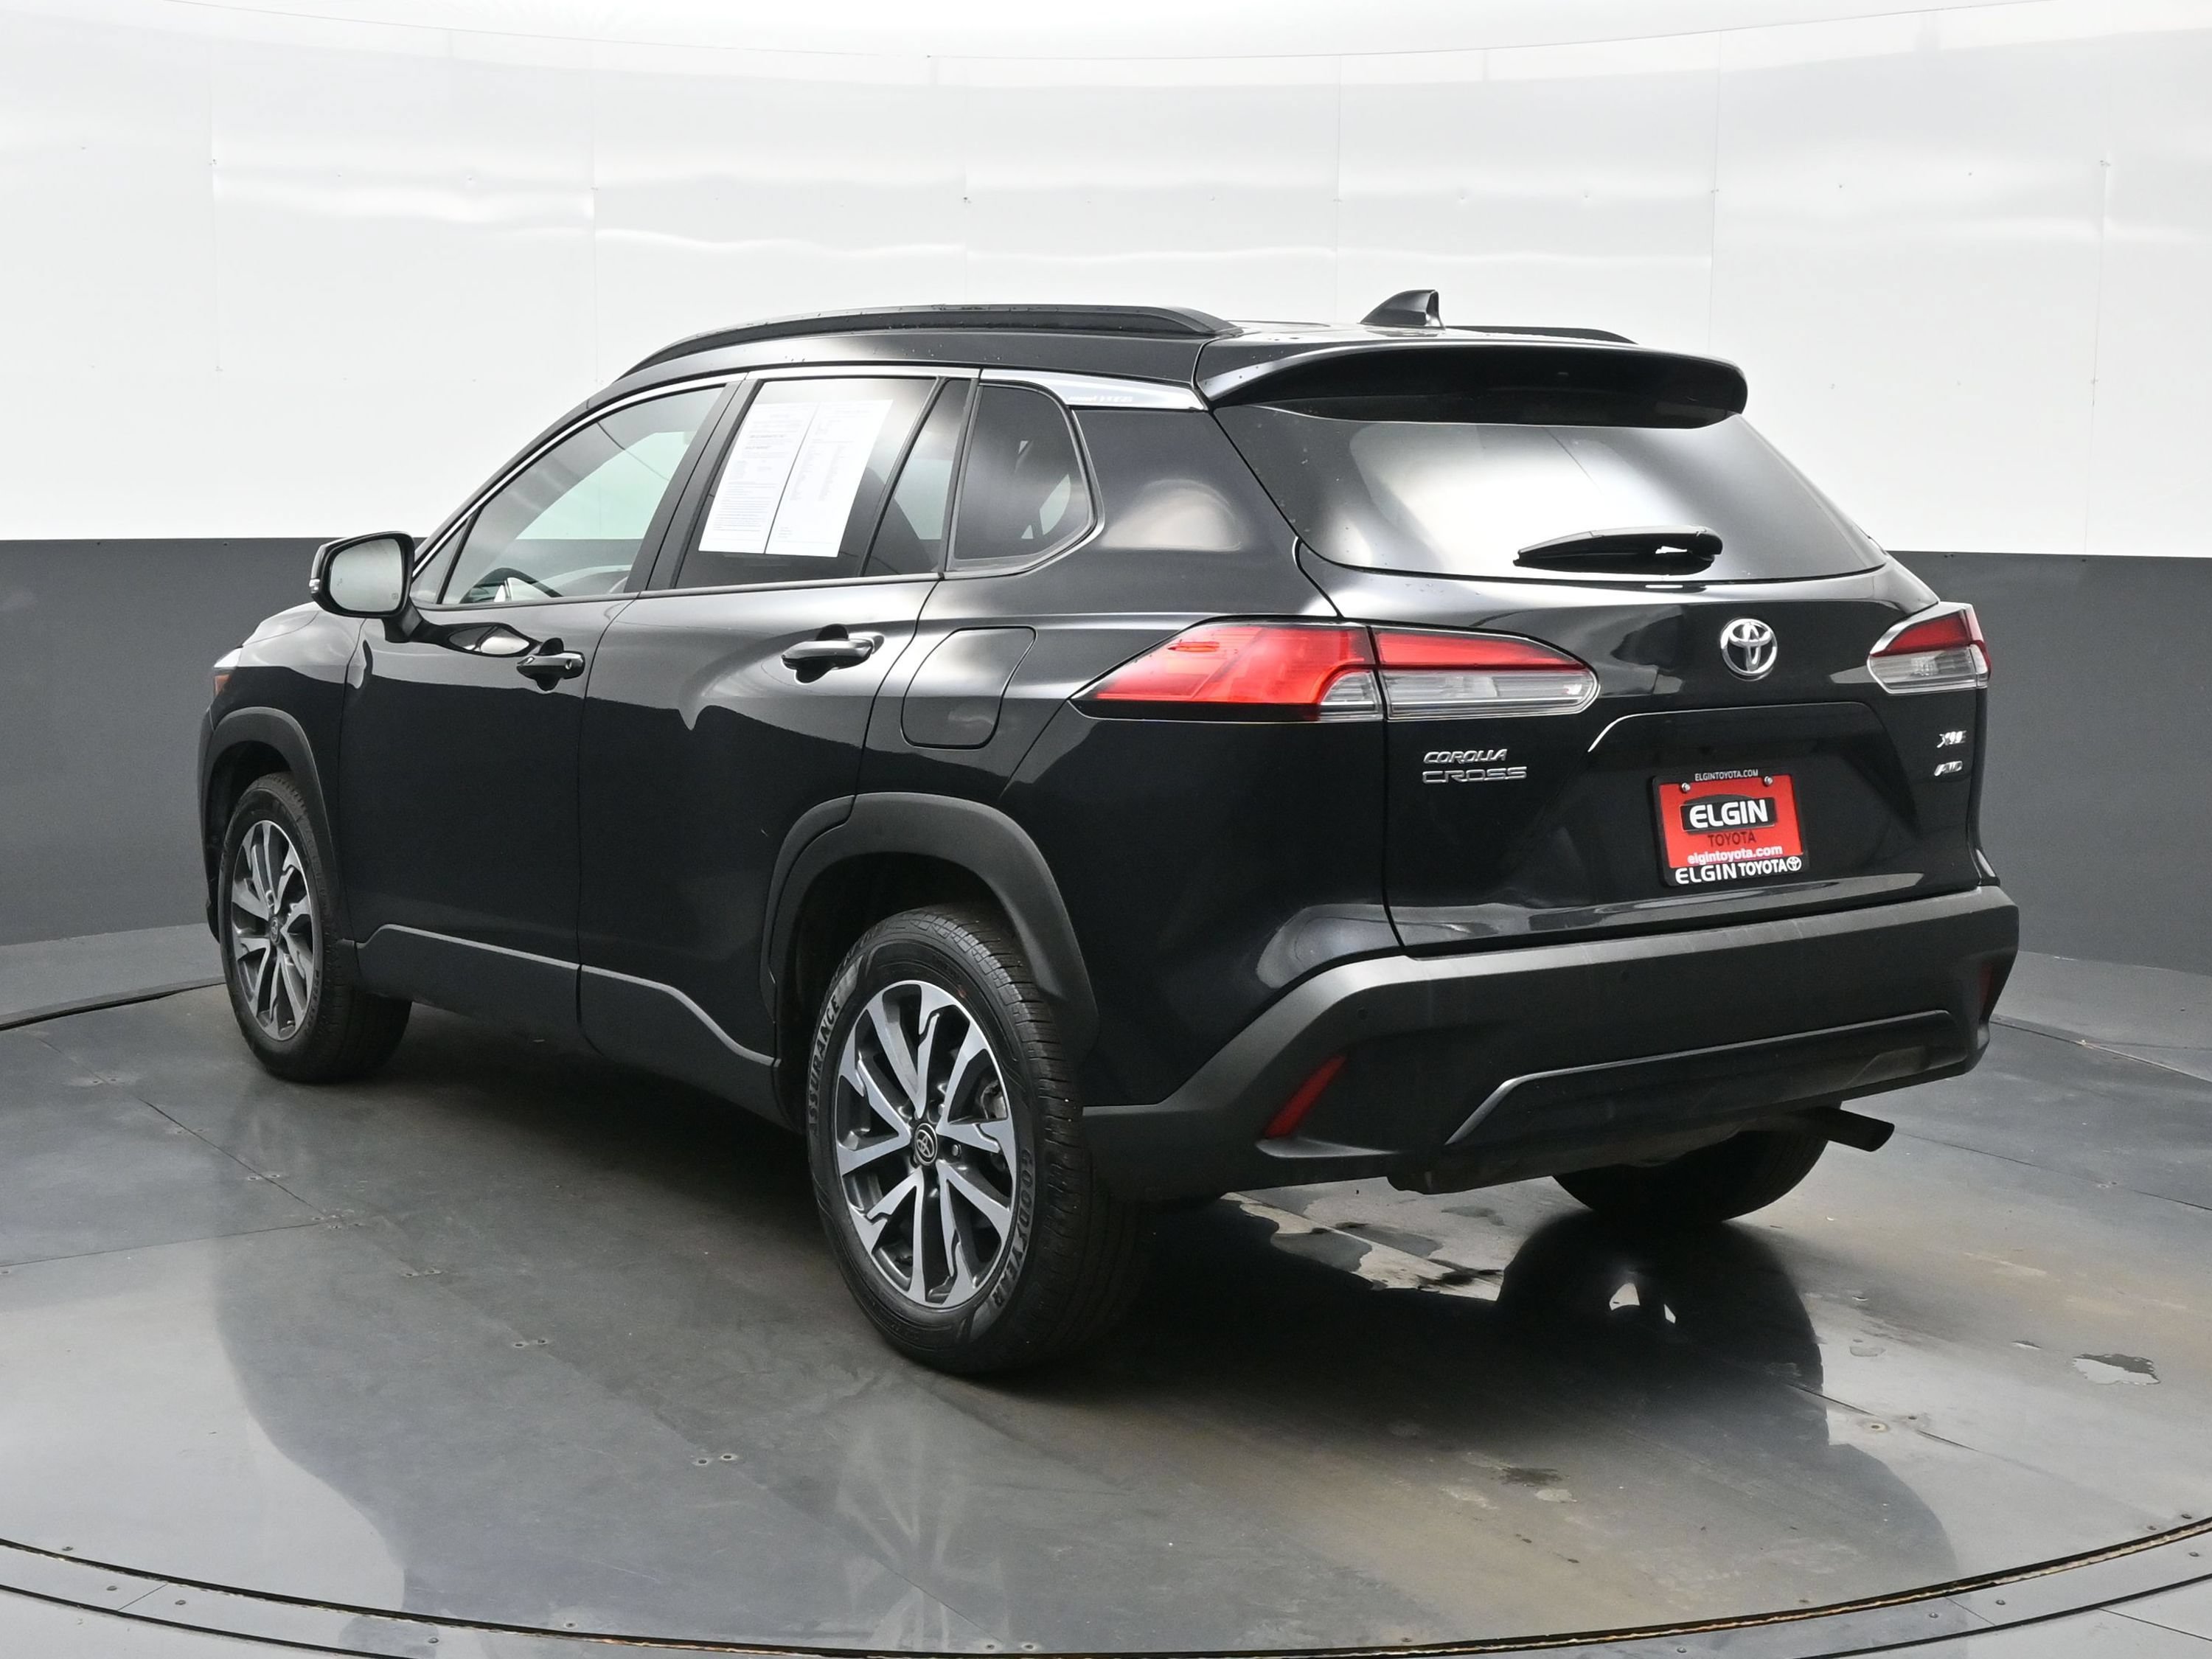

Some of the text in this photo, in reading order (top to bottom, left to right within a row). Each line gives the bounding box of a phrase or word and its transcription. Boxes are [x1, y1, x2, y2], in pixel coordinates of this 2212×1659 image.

[1423, 748, 1508, 764] COROLLA
[1422, 766, 1527, 785] CROSS
[1695, 769, 1759, 782] ELGINTOYOTA.COM
[1689, 799, 1768, 829] ELGIN
[1708, 831, 1756, 847] TOYOTA
[1687, 846, 1783, 866] elgintoyota.com
[1674, 858, 1788, 885] ELGIN TOYOTA
